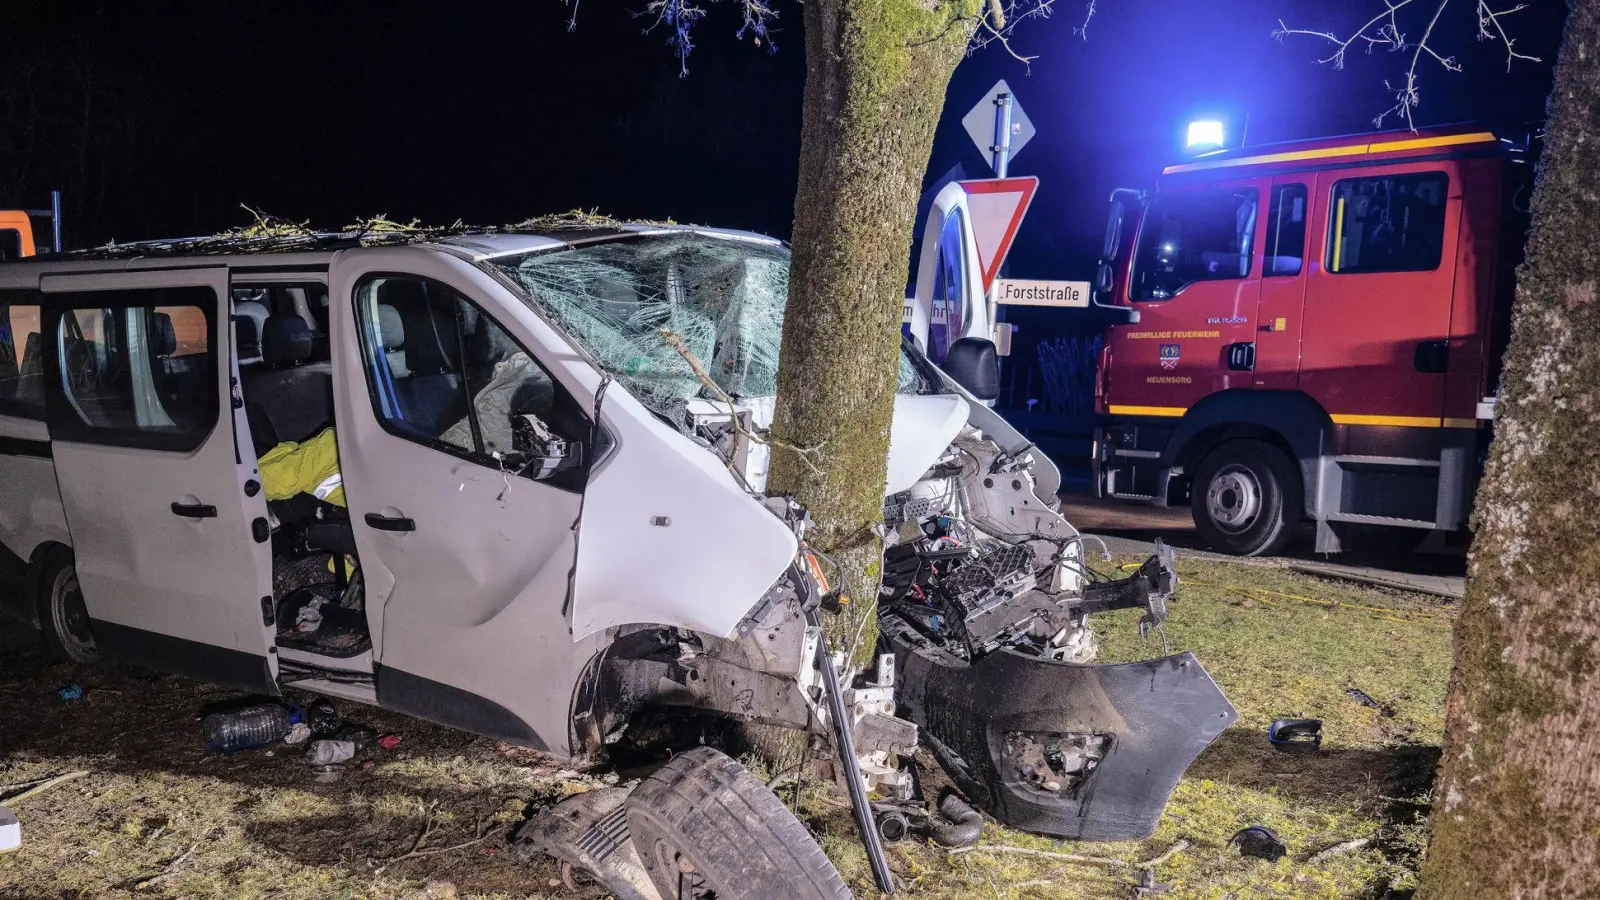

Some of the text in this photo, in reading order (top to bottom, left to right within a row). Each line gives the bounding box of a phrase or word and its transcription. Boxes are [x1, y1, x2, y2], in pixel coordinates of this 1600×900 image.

[1005, 284, 1080, 301] Forststraße
[1127, 330, 1220, 339] FREIWILLIGE FEUERWEHR
[1146, 376, 1192, 384] NEUENSORG
